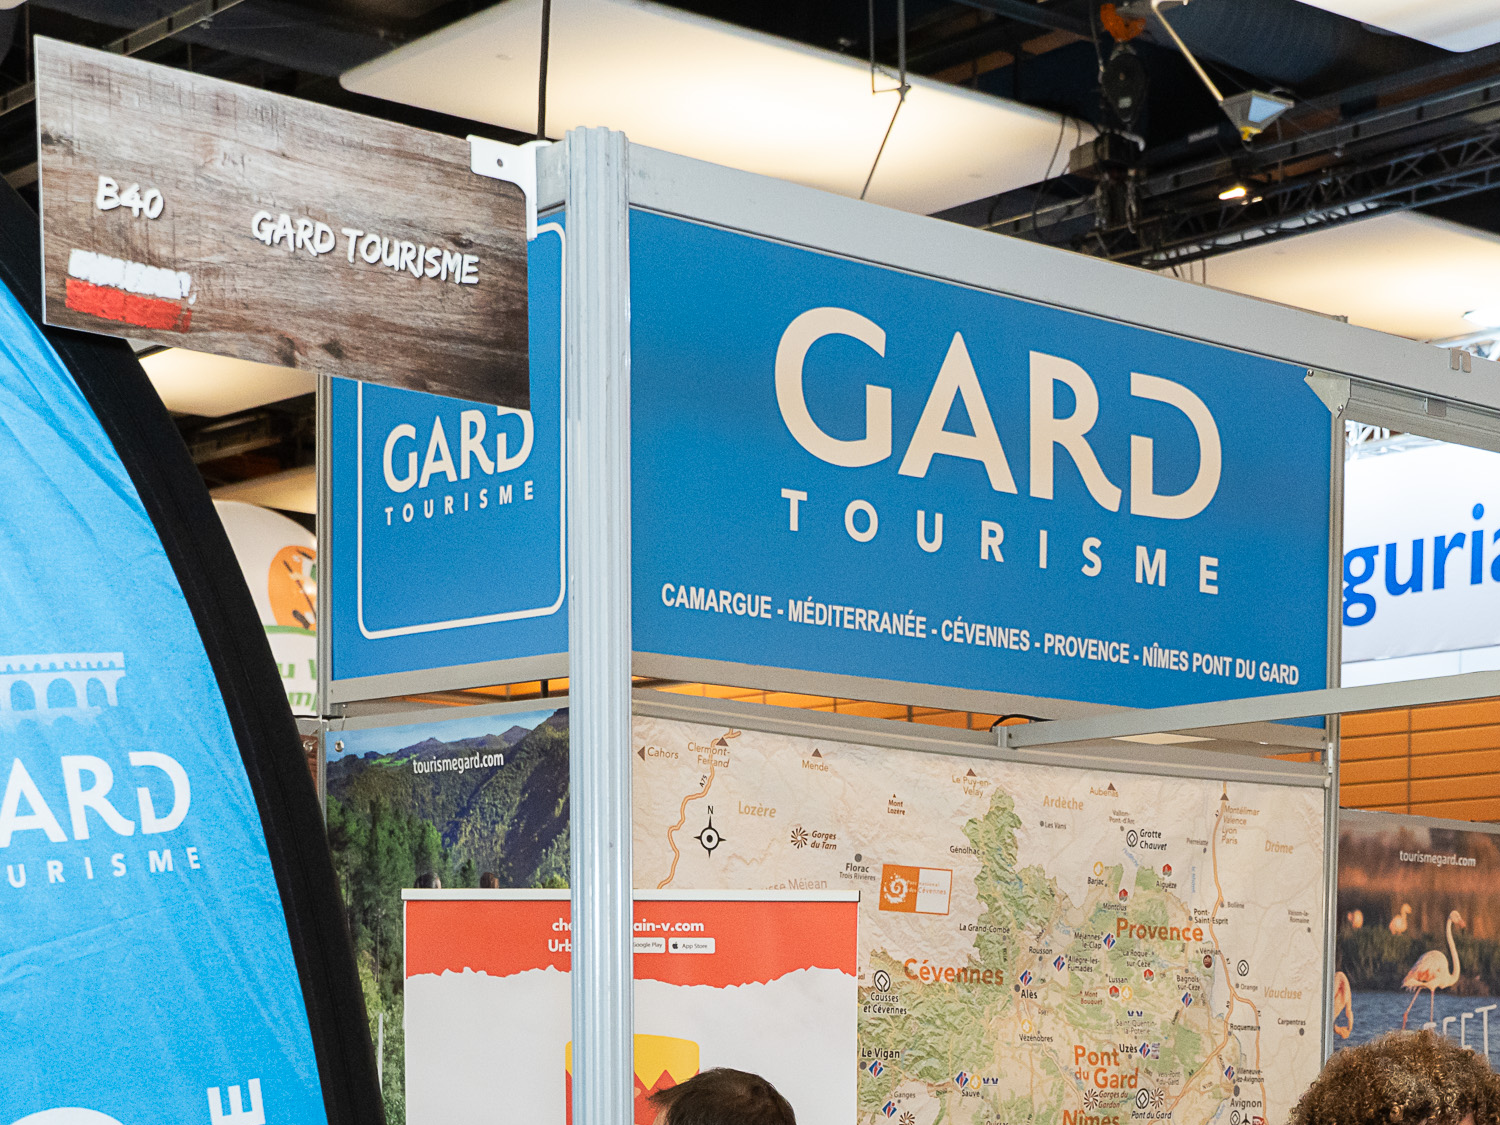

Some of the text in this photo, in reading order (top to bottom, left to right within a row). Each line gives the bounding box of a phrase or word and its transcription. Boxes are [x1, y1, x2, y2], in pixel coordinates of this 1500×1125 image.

[96, 176, 164, 220] B40
[252, 210, 480, 285] GARD TOURISME
[774, 306, 1222, 519] GARD
[383, 406, 535, 492] GARD
[385, 479, 534, 525] TOURISME
[781, 488, 1219, 594] TOURISME
[662, 583, 1299, 686] CAMARGUE MÉDITERRANÉE CÉVENNES PROVENCE NÎMES PONT DU GARD
[647, 747, 679, 760] Cahors
[687, 741, 730, 756] Clermont-
[412, 751, 504, 775] tourismegard.com
[697, 754, 730, 768] Ferrand
[802, 759, 829, 772] Mende
[963, 776, 992, 788] Puy-en-
[963, 786, 983, 798] Velay
[1089, 786, 1119, 798] Aubenas
[1043, 795, 1084, 811] Ardèche
[707, 805, 714, 815] N
[738, 801, 777, 818] Lozère
[1224, 805, 1260, 816] Montélimar
[811, 830, 836, 840] Gorges
[1140, 829, 1162, 839] Grotte
[810, 840, 837, 850] du Tarn
[1140, 841, 1168, 851] Chauvet
[1221, 836, 1238, 845] Paris
[950, 846, 980, 855] Génolhac
[1265, 840, 1294, 854] Drôme
[1399, 850, 1476, 868] tourismegard.com
[845, 863, 870, 873] Florac
[1193, 908, 1210, 916] Pont-
[1194, 917, 1229, 925] Saint-Esprit
[968, 923, 1010, 933] Grand-Combe
[1116, 917, 1203, 941] Provence
[1029, 946, 1053, 955] Rousson
[904, 958, 1004, 985] Cévennes
[870, 991, 899, 1002] Causses
[1020, 989, 1038, 999] Alès
[1264, 986, 1302, 999] Vaucluse
[872, 1004, 907, 1014] Cévennes
[1277, 1018, 1306, 1026] Carpentras
[861, 1048, 900, 1060] Le Vigan
[1118, 1043, 1138, 1053] Uzès
[1074, 1045, 1120, 1066] Pont
[1075, 1067, 1138, 1089] du Gard
[893, 1091, 916, 1100] Ganges
[961, 1089, 980, 1098] Sauve
[1099, 1090, 1120, 1099] Gorges
[1230, 1098, 1262, 1110] Avignon
[1131, 1111, 1172, 1119] Pont Gard
